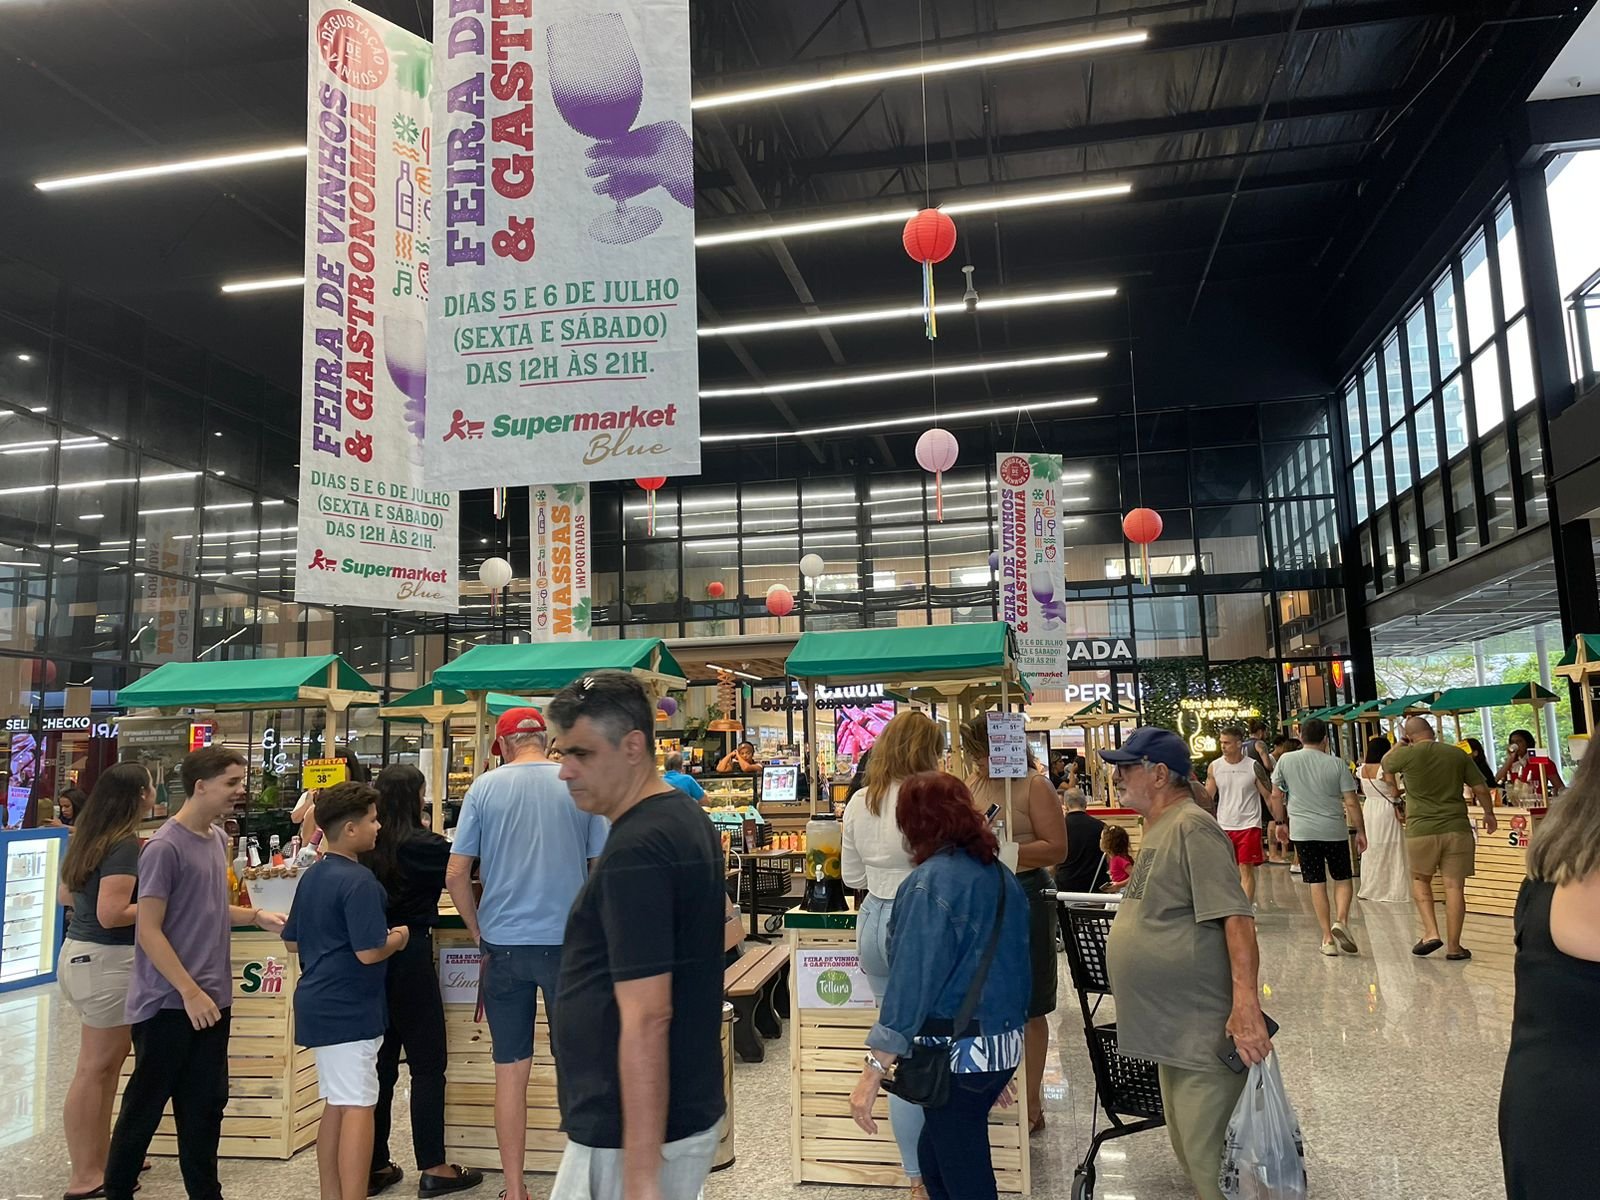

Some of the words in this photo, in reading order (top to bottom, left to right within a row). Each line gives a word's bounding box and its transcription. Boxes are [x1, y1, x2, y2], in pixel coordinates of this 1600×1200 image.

[322, 15, 385, 65] DEGUSTAÇÃO
[346, 41, 361, 58] DE
[317, 82, 348, 245] VINHOS
[446, 72, 486, 266] FEIRA
[491, 215, 535, 262] &
[345, 102, 377, 421] GASTRONOMIA
[316, 254, 345, 316] DE
[444, 290, 496, 317] DIAS
[503, 289, 517, 311] 5
[524, 287, 537, 308] E
[543, 284, 558, 306] 6
[565, 281, 594, 303] DE
[602, 278, 679, 303] JULHO
[453, 323, 534, 353] (SEXTA
[541, 321, 554, 342] E
[561, 311, 668, 341] SÁBADO)
[465, 362, 512, 386] DAS
[518, 357, 558, 380] 12H
[567, 351, 597, 377] ÀS
[604, 350, 655, 375] 21H.
[313, 327, 344, 458] FEIRA
[491, 403, 677, 440] Supermarket
[345, 429, 373, 462] &
[582, 428, 672, 466] Blue
[311, 470, 346, 490] DIAS
[350, 478, 359, 492] 5
[364, 479, 373, 493] E
[377, 481, 386, 496] 6
[390, 483, 407, 499] DE
[411, 487, 450, 507] JULHO
[318, 494, 370, 518] (SEXTA
[375, 504, 383, 518] E
[386, 504, 443, 529] SÁBADO)
[1002, 488, 1015, 552] VINHOS
[326, 520, 355, 538] DAS
[360, 525, 385, 542] 12H
[389, 526, 407, 545] ÀS
[411, 532, 436, 549] 21H.
[576, 514, 586, 589] IMPORTADAS
[1015, 489, 1028, 617] GASTRONOMIA
[341, 558, 447, 583] Supermarket
[551, 504, 573, 637] MASSAS
[1003, 556, 1015, 578] DE
[396, 579, 445, 600] Blue
[1004, 582, 1016, 622] EIRA
[1017, 621, 1028, 633] &
[6, 719, 30, 730] SEL
